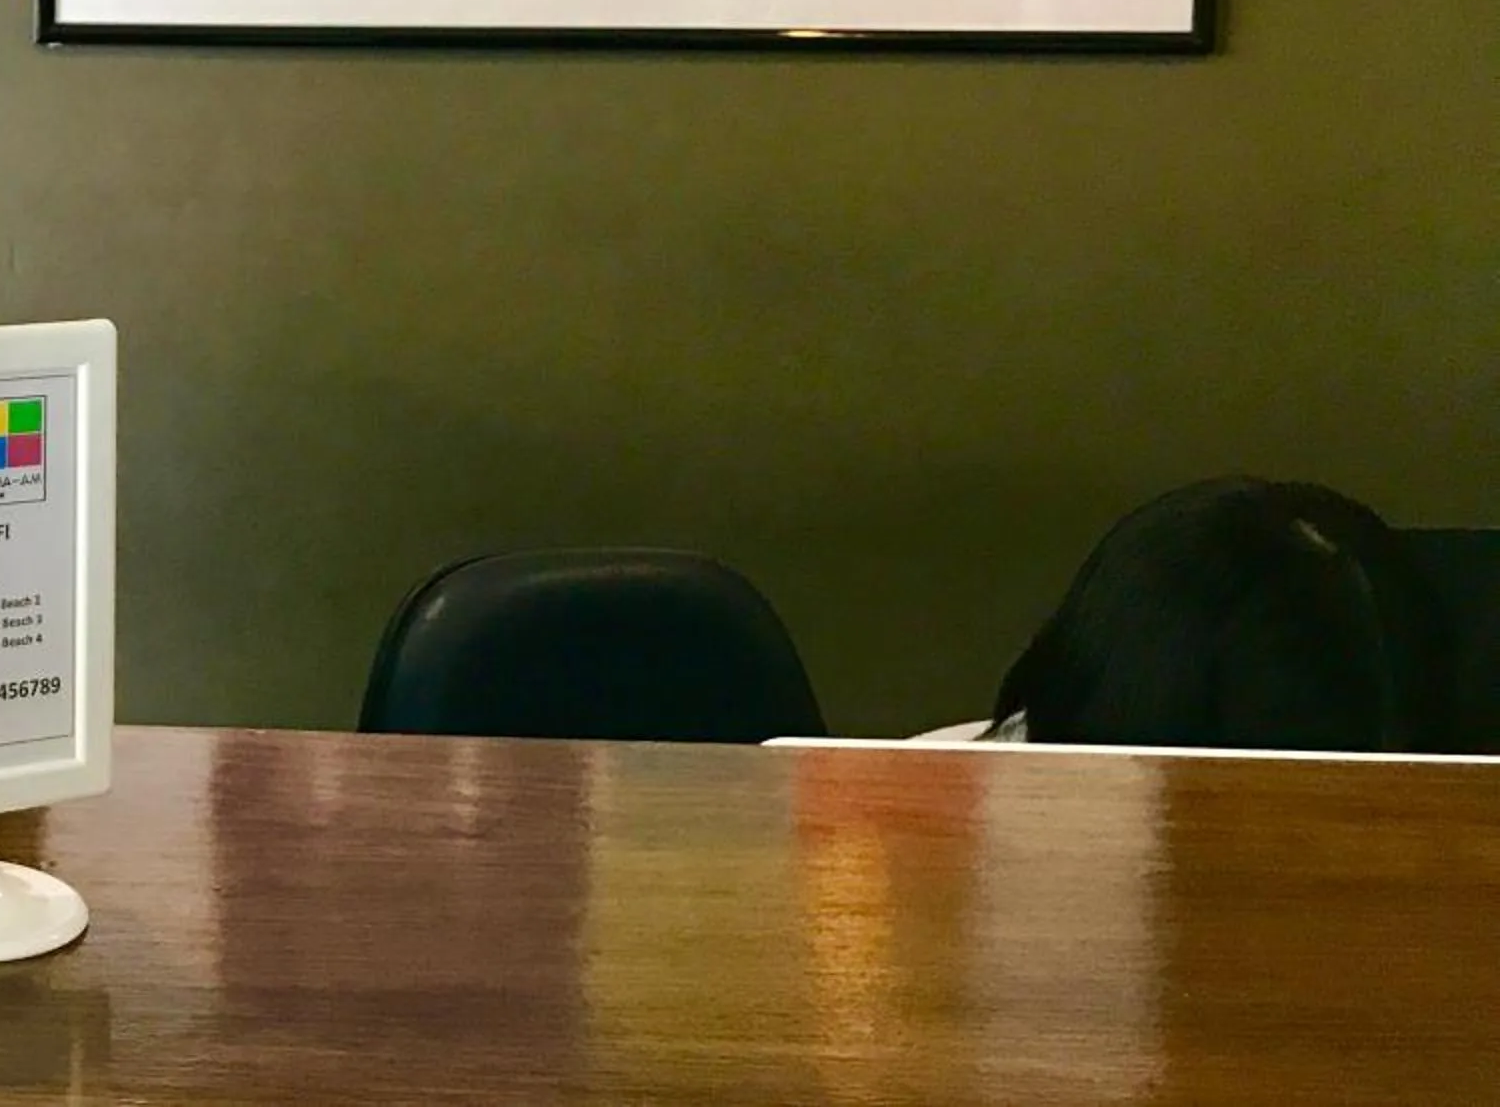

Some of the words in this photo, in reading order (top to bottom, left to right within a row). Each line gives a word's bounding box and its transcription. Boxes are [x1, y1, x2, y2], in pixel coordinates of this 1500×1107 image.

[1, 596, 33, 610] Beach
[2, 615, 33, 629] Beach
[2, 634, 33, 648] Beach
